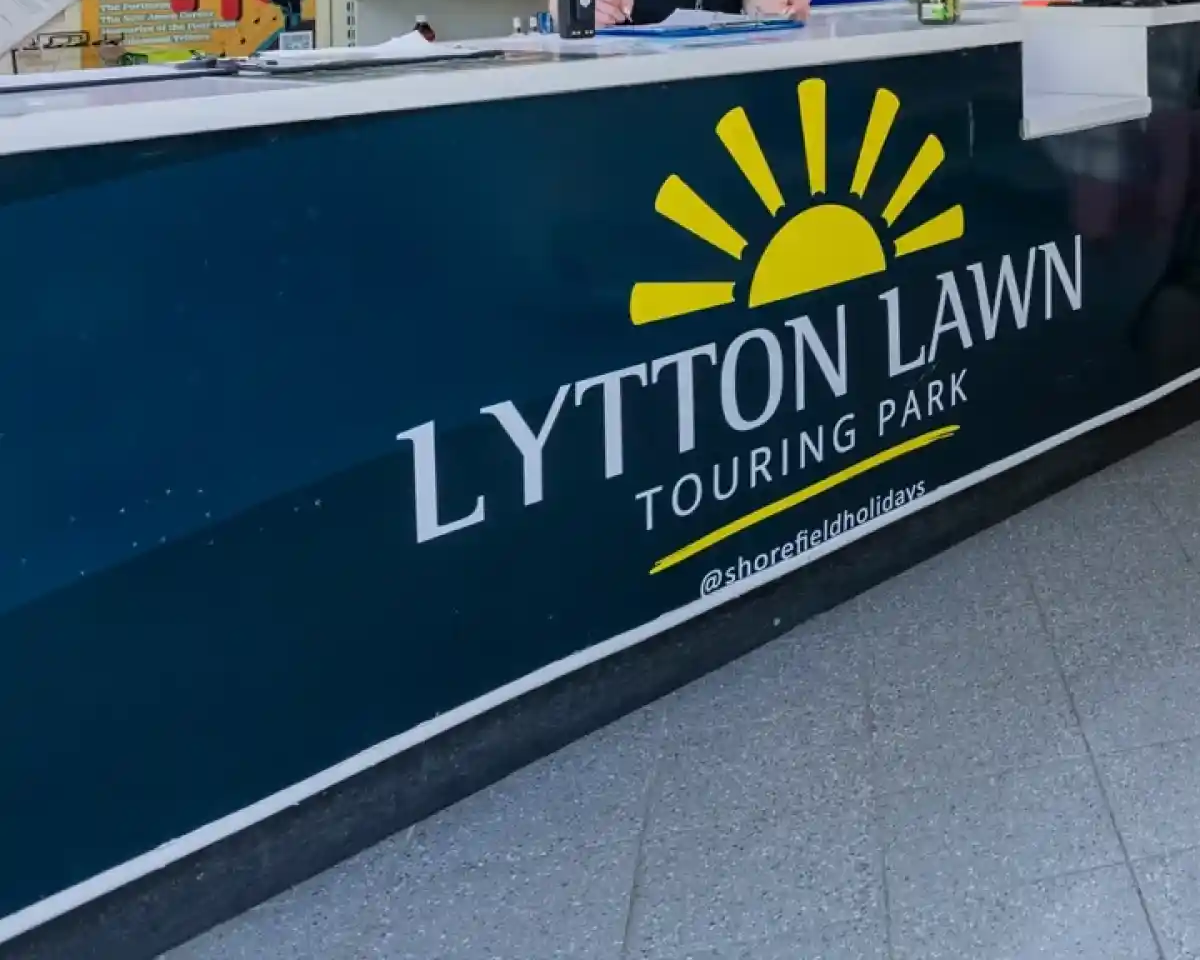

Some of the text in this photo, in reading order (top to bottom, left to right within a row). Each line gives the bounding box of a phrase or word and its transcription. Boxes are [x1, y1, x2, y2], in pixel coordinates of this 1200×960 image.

[396, 234, 1083, 544] LYTTON LAWN
[635, 369, 969, 530] TOURING PARK
[700, 479, 926, 597] @shorefieldholidays
